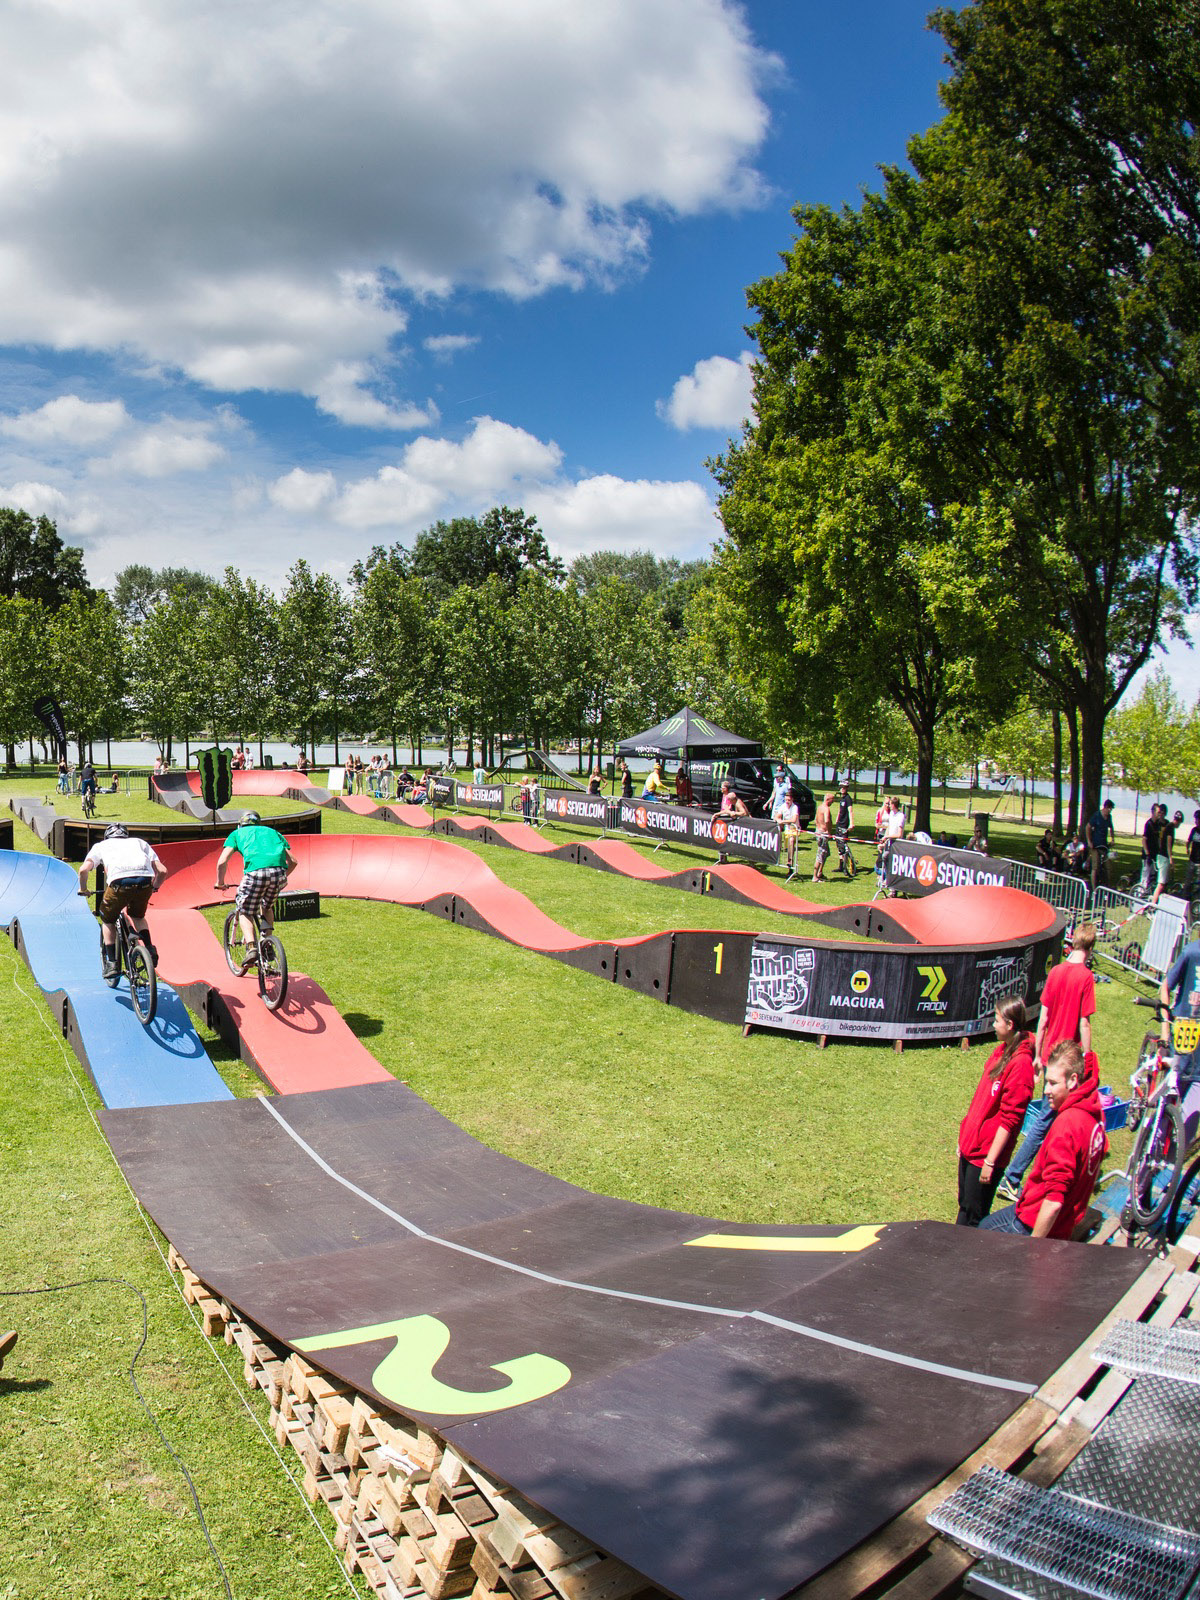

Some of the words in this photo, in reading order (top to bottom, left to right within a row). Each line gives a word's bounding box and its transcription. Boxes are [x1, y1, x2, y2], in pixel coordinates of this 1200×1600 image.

[635, 745, 660, 754] MONSTER
[567, 800, 605, 819] SEVEN.COM
[646, 810, 688, 833] SEVEN.COM
[693, 819, 712, 839] BMX
[727, 824, 778, 852] SEVEN.COM
[705, 872, 711, 892] 1
[891, 854, 917, 879] BMX
[919, 859, 933, 881] 24
[936, 862, 1004, 887] SEVENCOM
[713, 942, 724, 975] 1
[751, 955, 794, 979] UMP
[829, 994, 885, 1010] MAGURA
[682, 1224, 888, 1252] 1
[288, 1313, 572, 1415] 2
